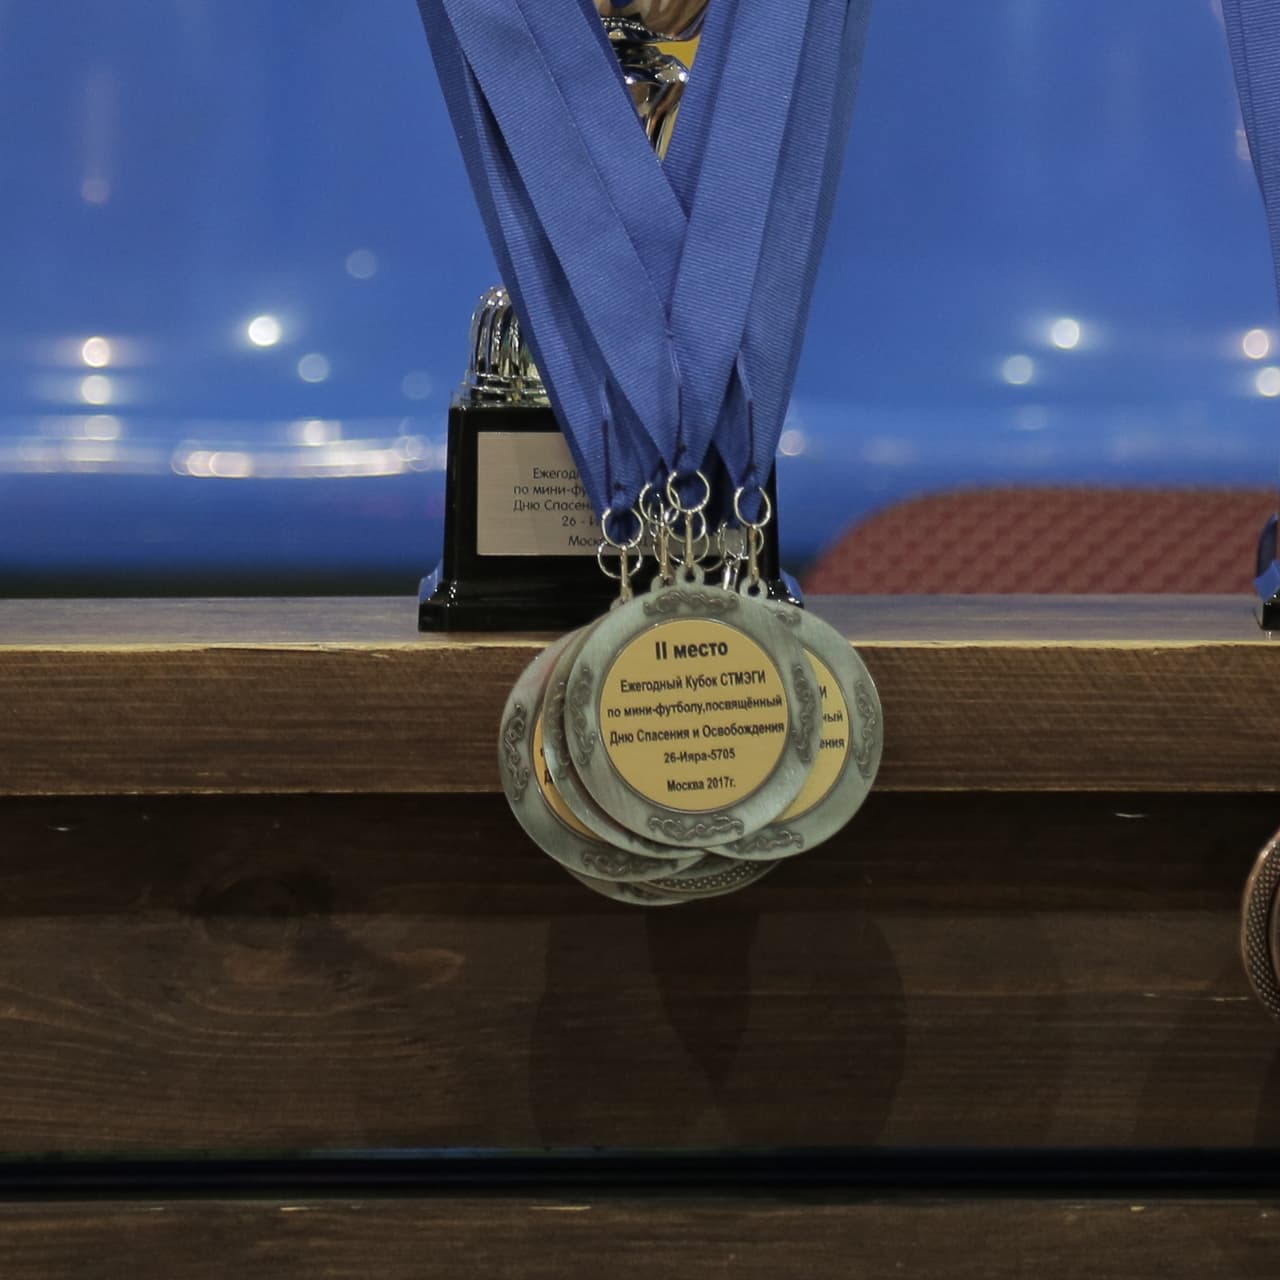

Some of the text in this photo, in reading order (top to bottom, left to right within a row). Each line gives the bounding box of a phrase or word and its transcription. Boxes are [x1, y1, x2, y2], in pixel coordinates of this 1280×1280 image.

[514, 486, 529, 495] по
[513, 500, 540, 512] Дню
[656, 641, 728, 660] II место
[620, 670, 766, 694] Ежегодный Кубок СТМЭГИ
[607, 707, 621, 718] по
[610, 722, 785, 746] Дню Спасения и Освобождения
[664, 748, 736, 764] 26-Ияра-5705
[667, 776, 736, 792] Москва 2017г.
